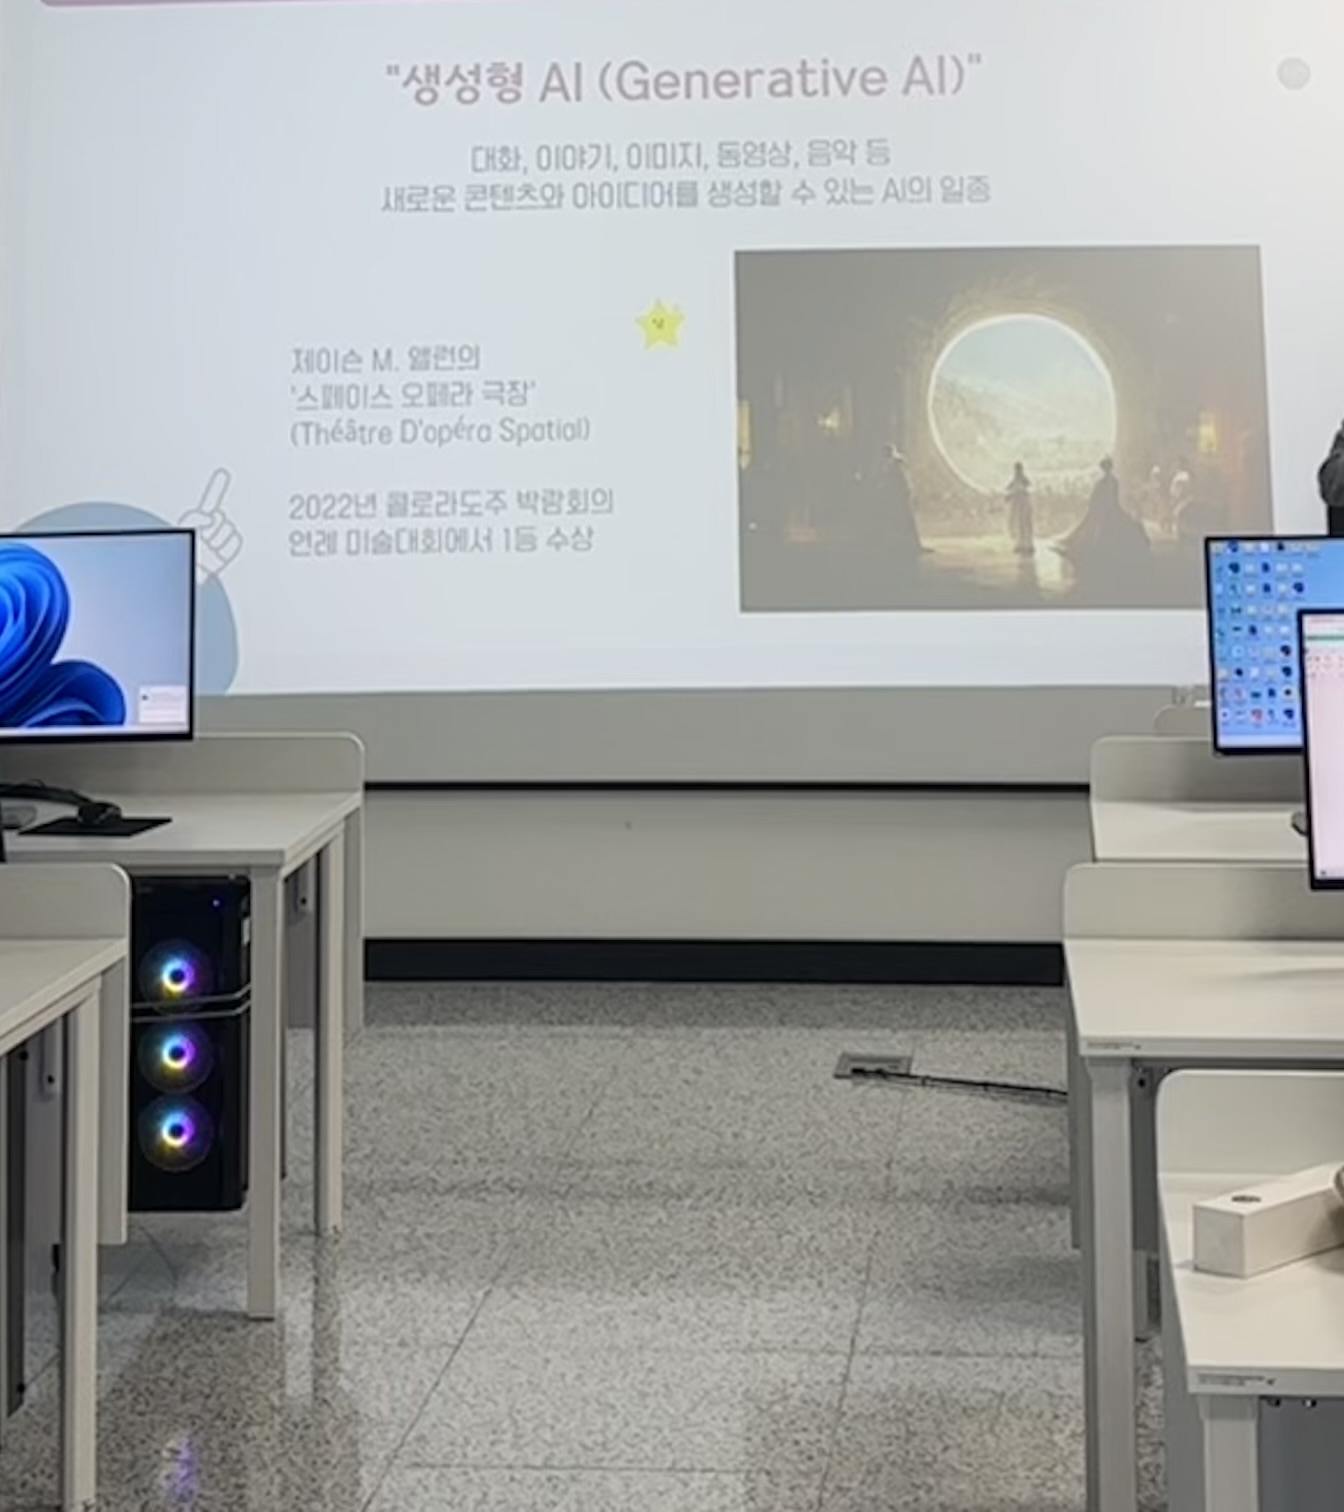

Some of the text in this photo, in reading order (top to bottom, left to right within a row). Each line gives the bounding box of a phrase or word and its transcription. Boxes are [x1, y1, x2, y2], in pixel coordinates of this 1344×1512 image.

[538, 61, 583, 103] AI
[598, 57, 889, 102] (Generative
[471, 144, 529, 176] 대화,
[535, 143, 619, 173] 이야기,
[625, 141, 710, 172] 이미지,
[717, 139, 800, 170] 동영상,
[866, 137, 891, 167] 등
[380, 184, 457, 213] 새로운
[464, 182, 565, 212] 콘텐츠와
[572, 181, 699, 210] 아이디어를
[707, 178, 783, 209] 생성할
[790, 178, 817, 206] 수
[823, 176, 875, 206] 있는
[881, 175, 933, 204] AI의
[291, 346, 364, 375] 제이슨
[372, 347, 399, 372] M.
[401, 380, 474, 409] 오페라
[498, 416, 591, 448] Spatial)
[288, 492, 377, 521] 2022년
[516, 487, 614, 516] 박람회의
[503, 525, 538, 553] 1등
[545, 525, 595, 552] 수상
